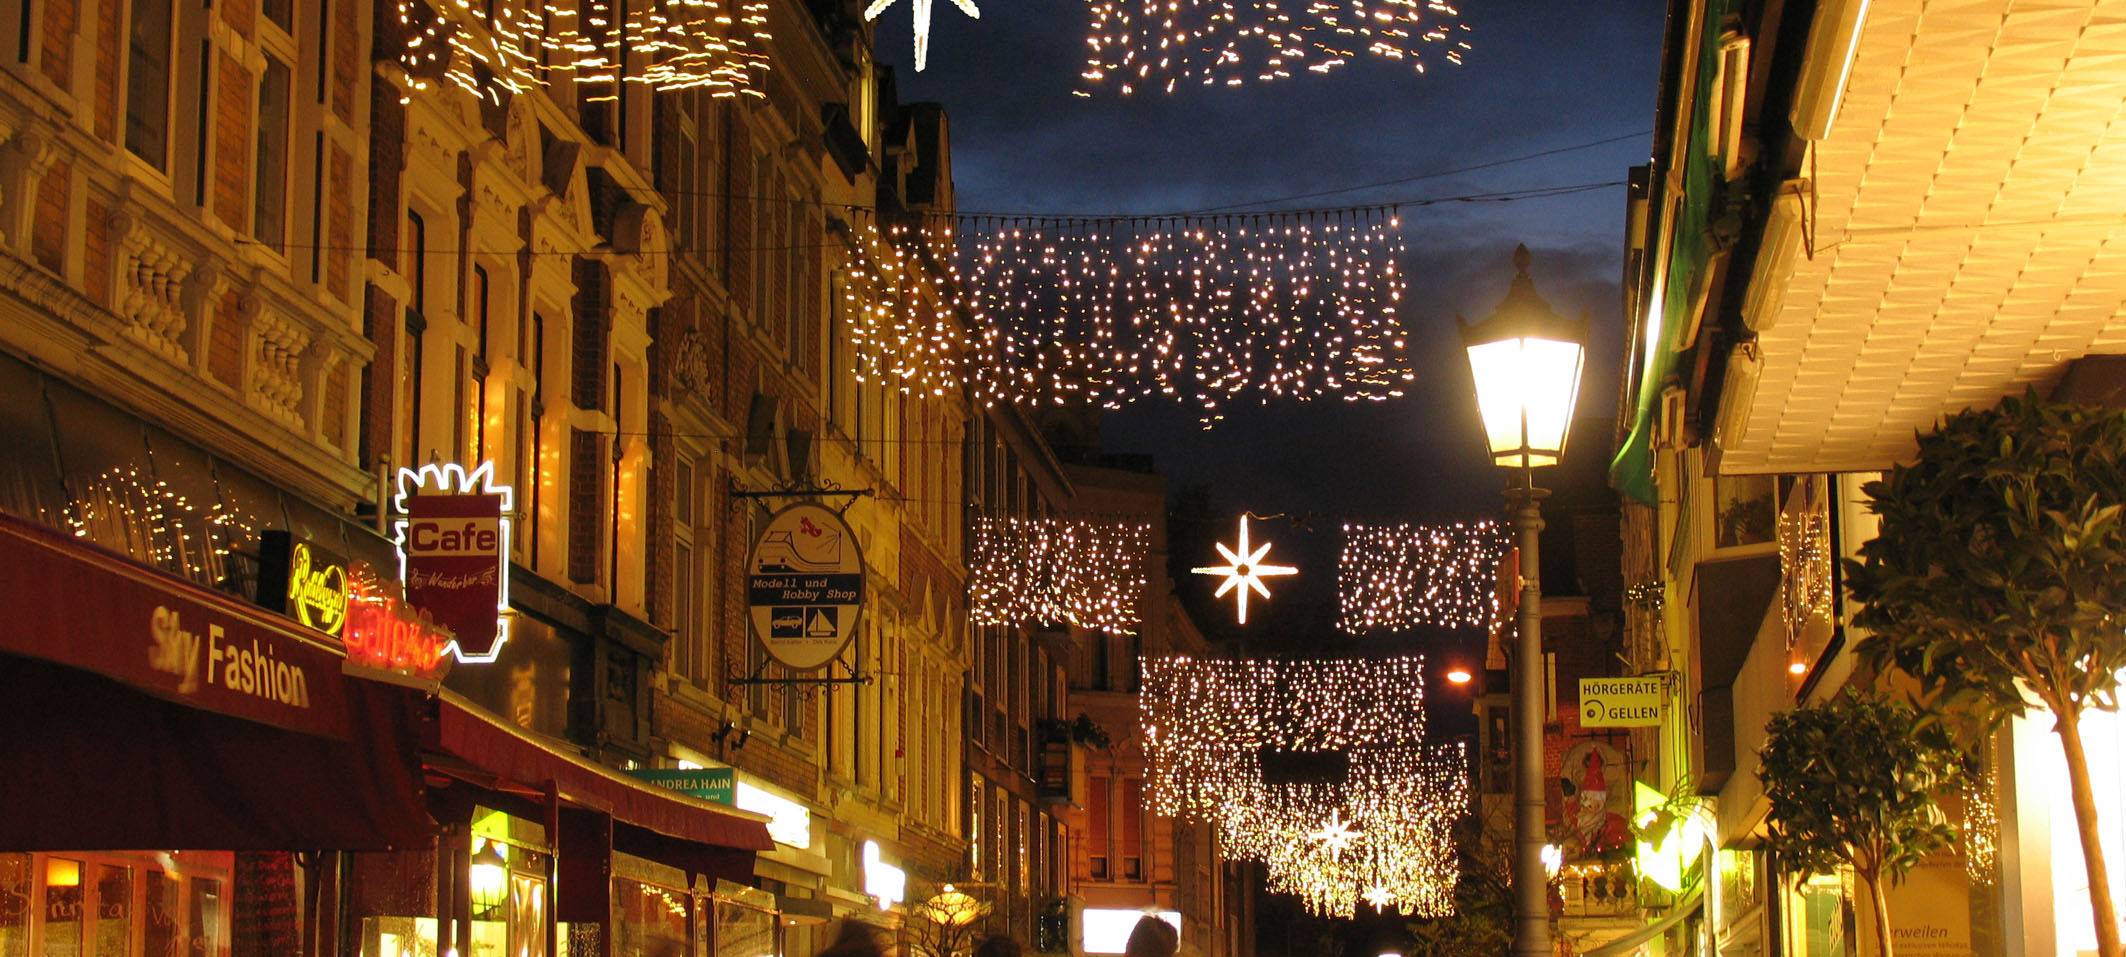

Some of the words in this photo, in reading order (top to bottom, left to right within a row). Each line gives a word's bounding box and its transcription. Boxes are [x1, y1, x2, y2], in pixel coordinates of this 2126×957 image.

[411, 522, 496, 551] Cafe
[753, 578, 797, 588] Modell
[805, 578, 828, 588] und
[782, 590, 820, 601] Hobby
[826, 589, 857, 600] Shop
[207, 623, 310, 708] Fashion
[1583, 681, 1657, 695] HÖRGERÄTE
[1608, 706, 1658, 719] GELLEN
[651, 778, 698, 790] NDREA
[701, 778, 731, 789] HAIN
